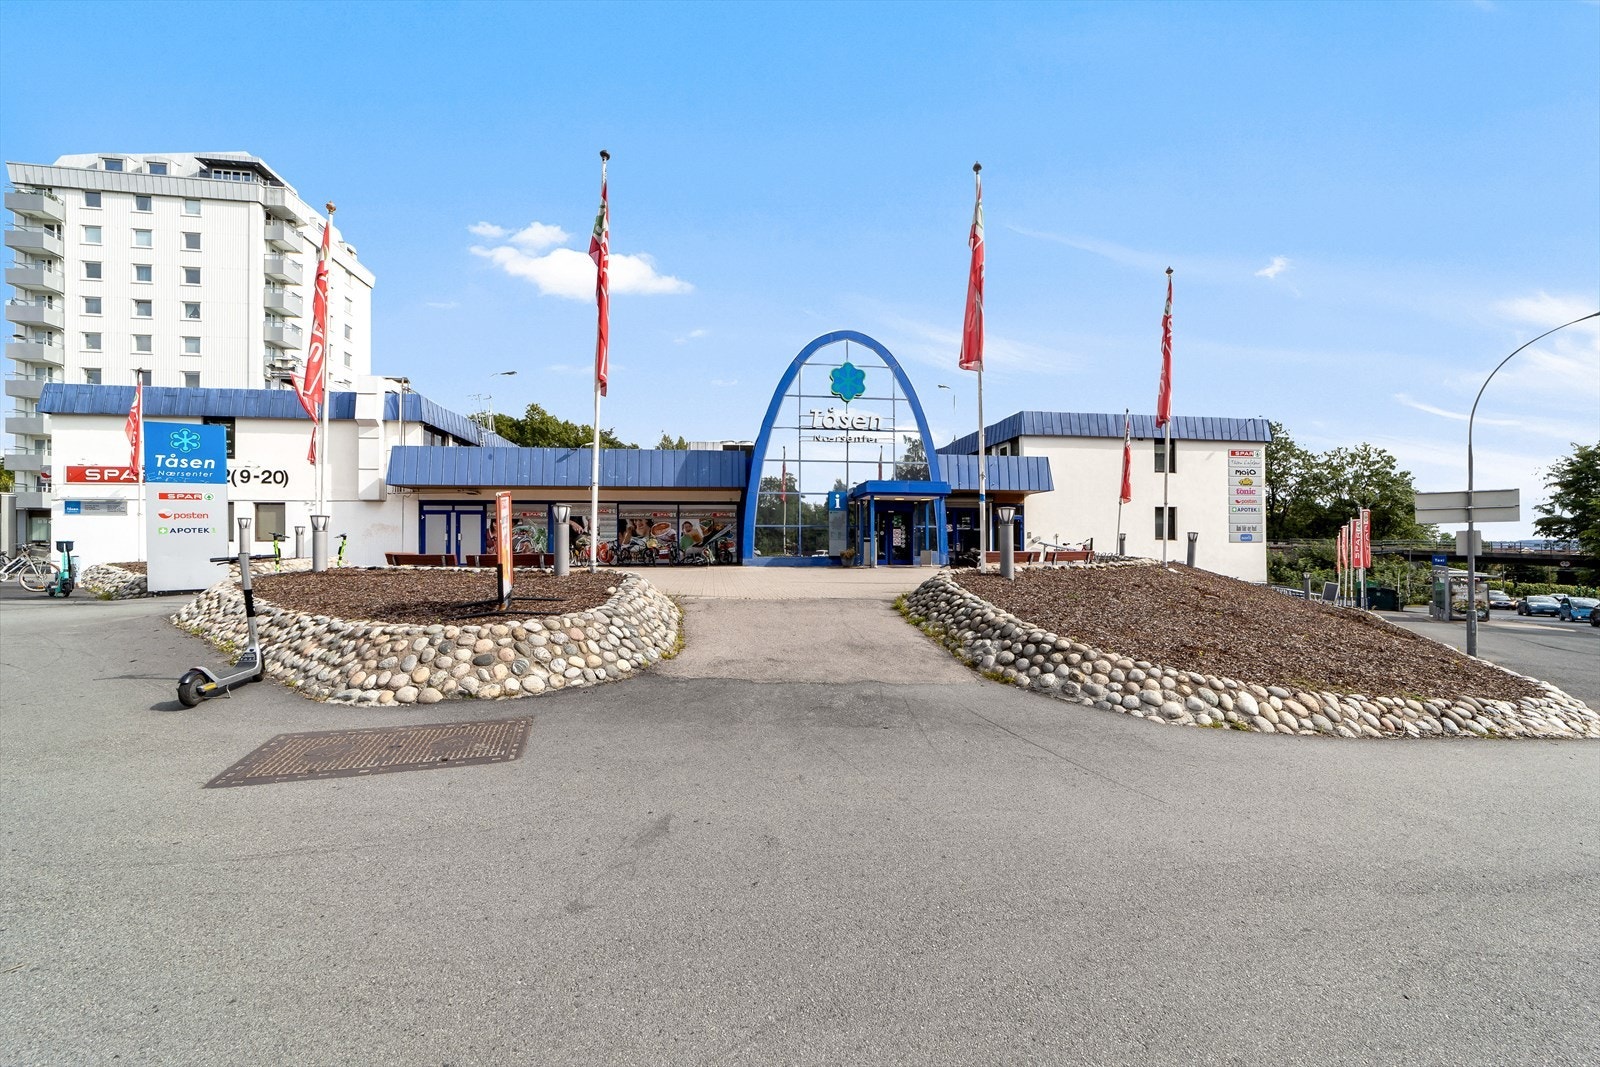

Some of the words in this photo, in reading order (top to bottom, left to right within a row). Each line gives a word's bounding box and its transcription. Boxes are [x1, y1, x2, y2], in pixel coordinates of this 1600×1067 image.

[810, 407, 880, 431] Tåsen
[155, 453, 216, 469] Tåsen
[158, 470, 213, 478] Nærsenter
[173, 512, 209, 520] posten
